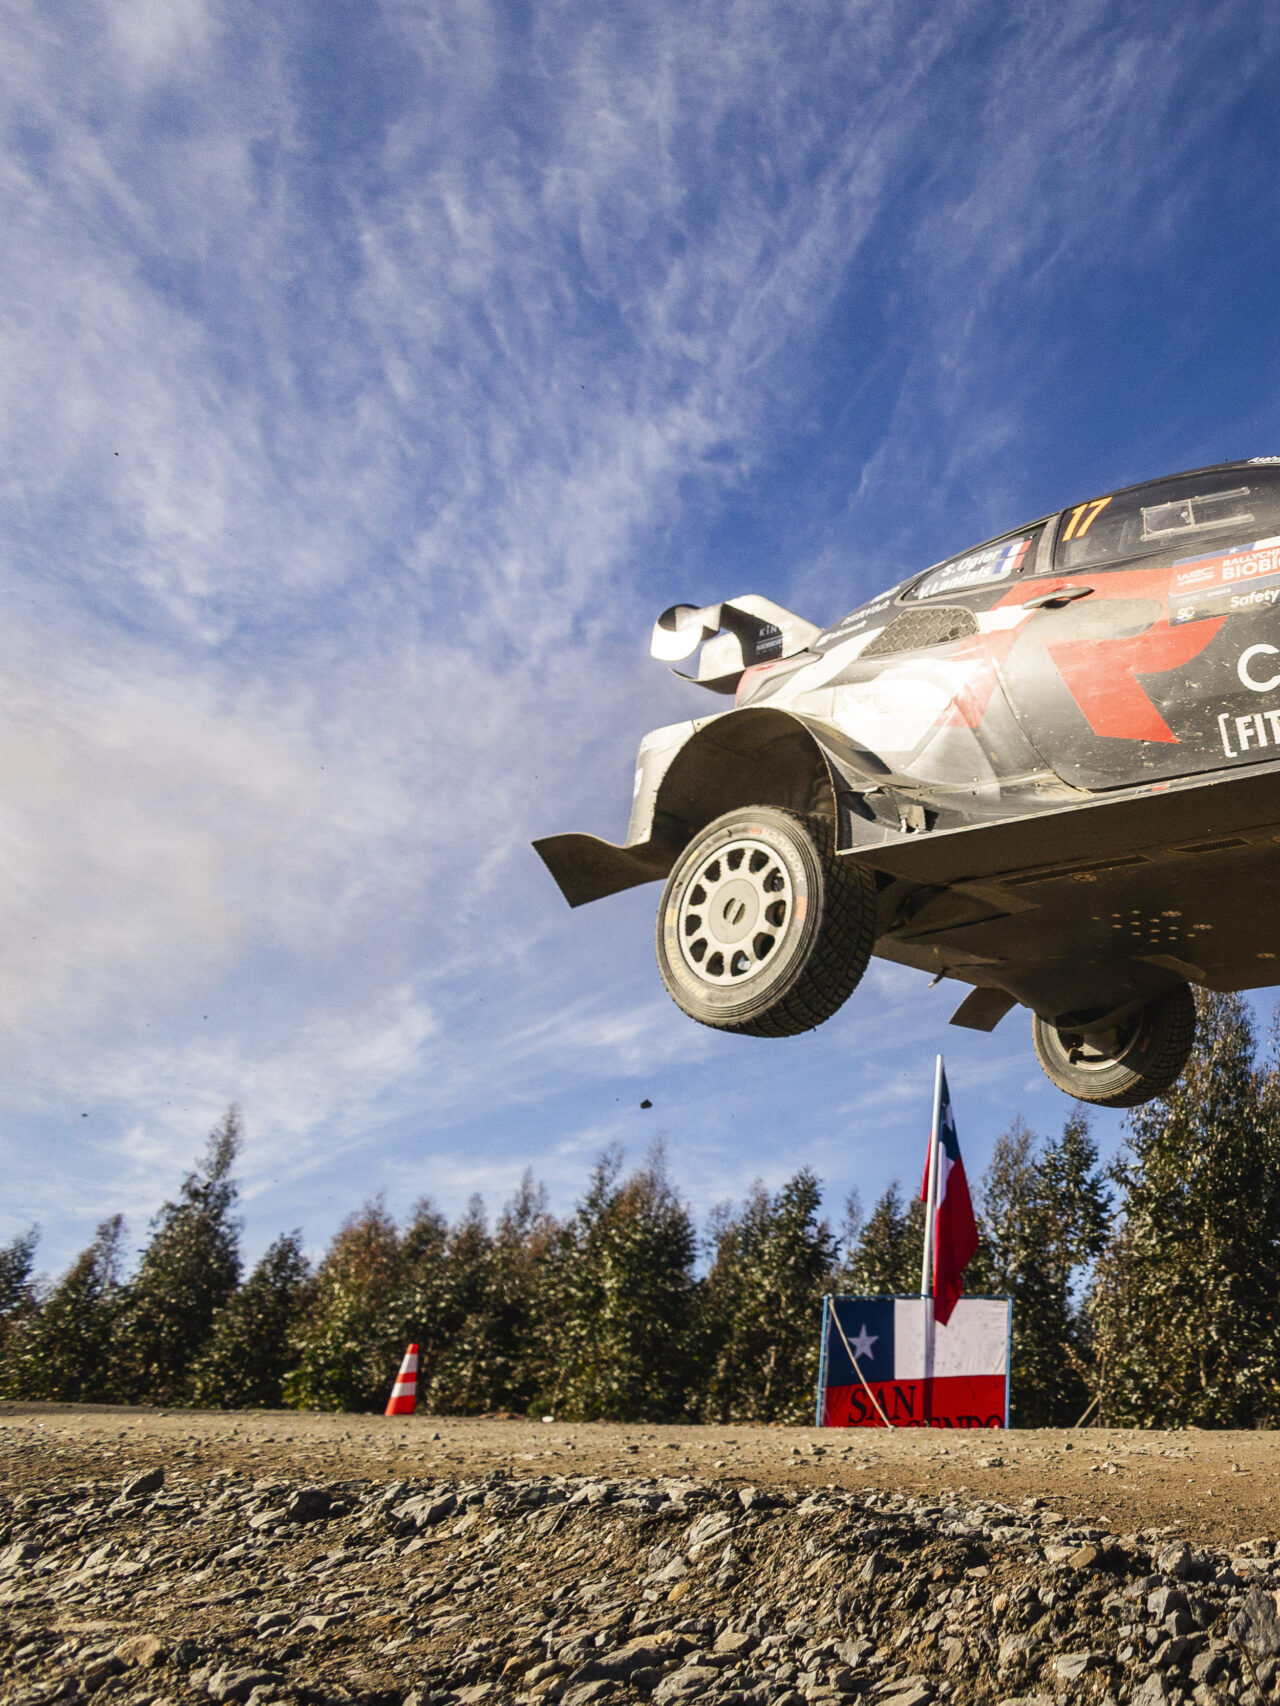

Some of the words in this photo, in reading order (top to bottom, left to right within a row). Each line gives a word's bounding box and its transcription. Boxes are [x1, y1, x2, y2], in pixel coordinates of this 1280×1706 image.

[1062, 496, 1113, 542] 17
[957, 549, 1004, 571] Ogier
[848, 1385, 917, 1424] SAN
